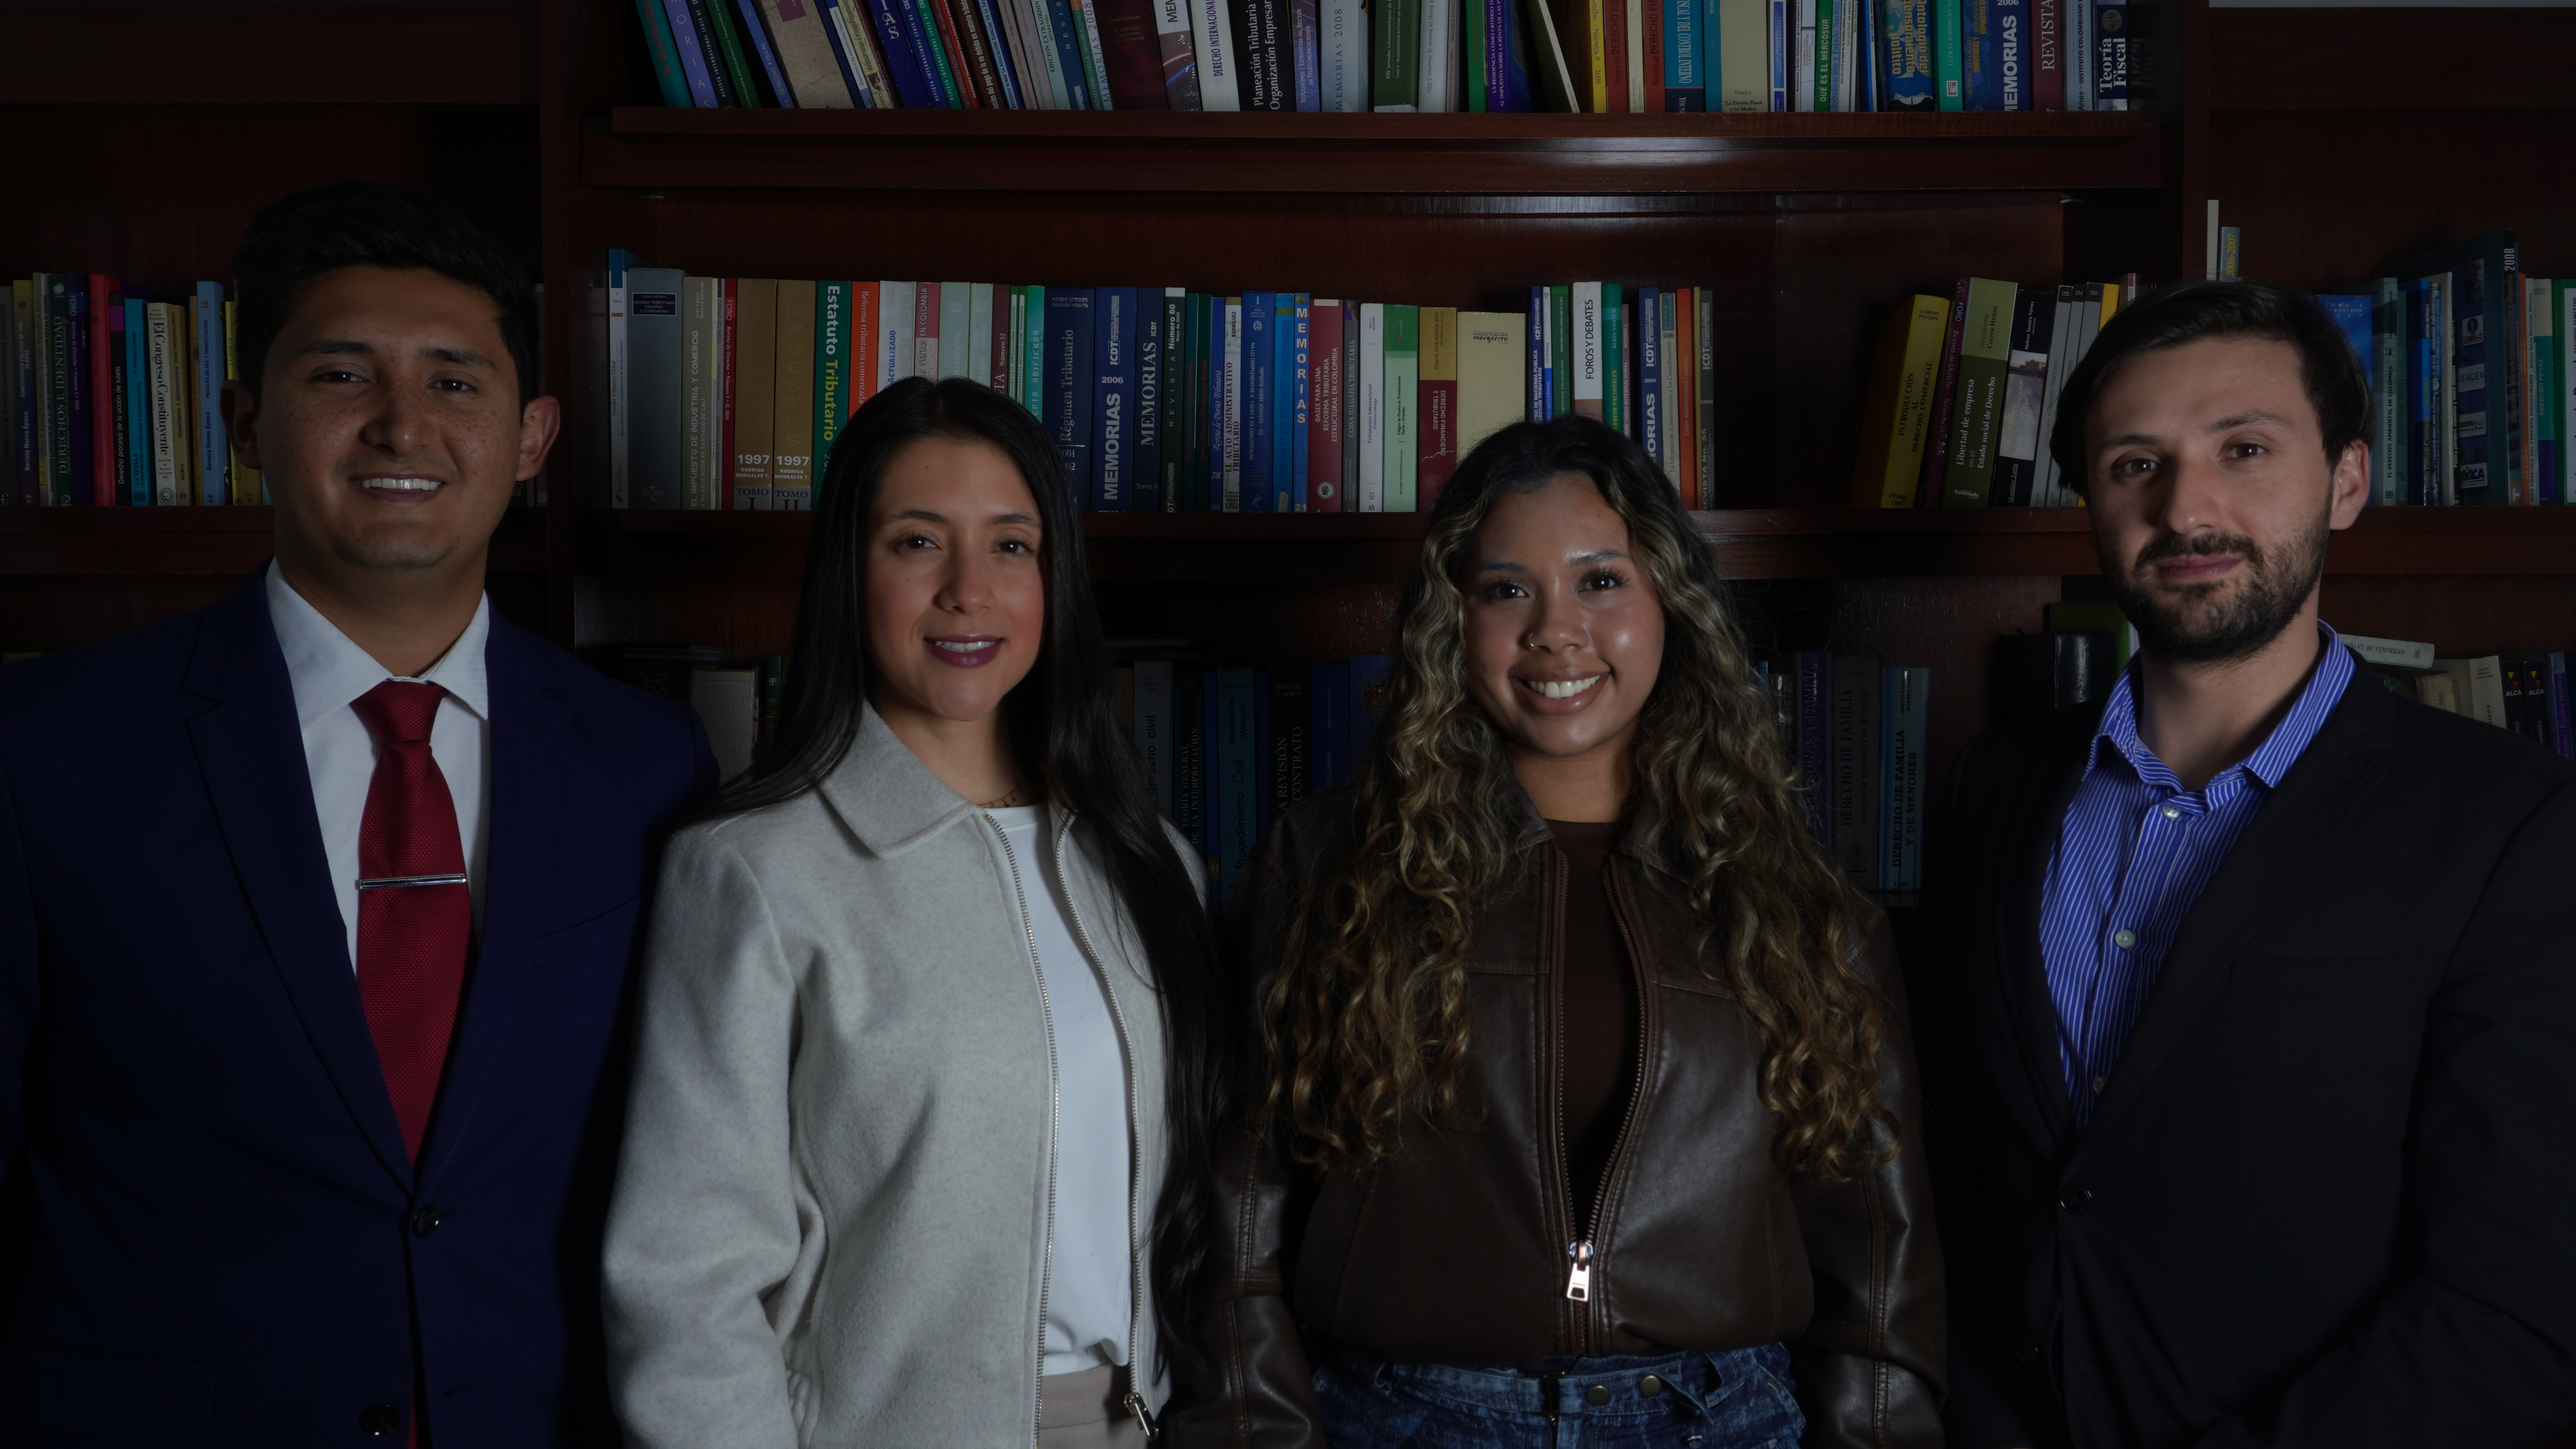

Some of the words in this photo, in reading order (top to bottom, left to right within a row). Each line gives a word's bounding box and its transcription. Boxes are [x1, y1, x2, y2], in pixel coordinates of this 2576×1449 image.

[963, 14, 975, 33] materia
[1246, 3, 1259, 51] Tributaria
[1610, 10, 1620, 53] DERECHO
[2041, 0, 2055, 70] REVISTA
[916, 39, 932, 78] INTERNACIONAL
[971, 39, 982, 56] debido
[2099, 38, 2114, 93] Teoría
[2113, 38, 2126, 87] Fiscal
[983, 73, 993, 87] pago
[1249, 52, 1264, 105] Planeación
[1265, 47, 1282, 109] Organización
[1820, 75, 1827, 83] ES
[1821, 63, 1827, 71] EL
[930, 81, 939, 101] REVISTA
[1830, 62, 1838, 112] Globalización
[2224, 232, 2238, 277] 2006-2007
[2504, 247, 2515, 271] 2008
[826, 286, 839, 355] Estatuto
[1169, 303, 1176, 314] 60
[1585, 300, 1593, 338] DEBATES
[1979, 315, 1989, 348] Magdalena
[54, 316, 64, 388] IDENTIDAD
[887, 330, 896, 382] ACTUALIZADO
[1061, 330, 1074, 388] Tributario
[1110, 340, 1119, 365] ICDT
[1297, 308, 1307, 424] MEMORIAS
[1586, 348, 1594, 379] FOROS
[823, 360, 838, 441] Tributario
[1141, 342, 1156, 445] MEMORIAS
[1332, 386, 1337, 394] EN
[1898, 373, 1914, 435] INTRODUCCIÓN
[1911, 400, 1918, 410] AL
[1912, 413, 1923, 452] DERECHO
[1919, 362, 1932, 409] COMERCIAL
[1965, 379, 1977, 415] empresa
[1985, 377, 1996, 408] Derecho
[1060, 391, 1074, 441] Régimen
[1961, 417, 1970, 427] de
[1980, 421, 1990, 442] social
[1984, 410, 1991, 419] de
[57, 404, 67, 473] DERECHOS
[691, 435, 697, 446] DE
[1104, 392, 1121, 500] MEMORIAS
[1956, 430, 1968, 464] Libertad
[1977, 445, 1986, 468] Estado
[738, 454, 769, 464] 1997
[1225, 463, 1231, 471] EL
[690, 496, 697, 506] EL
[1228, 698, 1235, 708] de
[1146, 715, 1155, 737] civil
[1233, 760, 1243, 783] Civil
[1276, 737, 1287, 797] REVISIÓN
[1292, 727, 1302, 800] CONTRATO
[1895, 729, 1905, 781] FAMILIA
[1894, 785, 1903, 802] DE
[1906, 751, 1916, 813] MENORES
[1235, 792, 1246, 868] Procedimiento
[1893, 806, 1903, 868] DERECHO
[1906, 816, 1914, 834] DE
